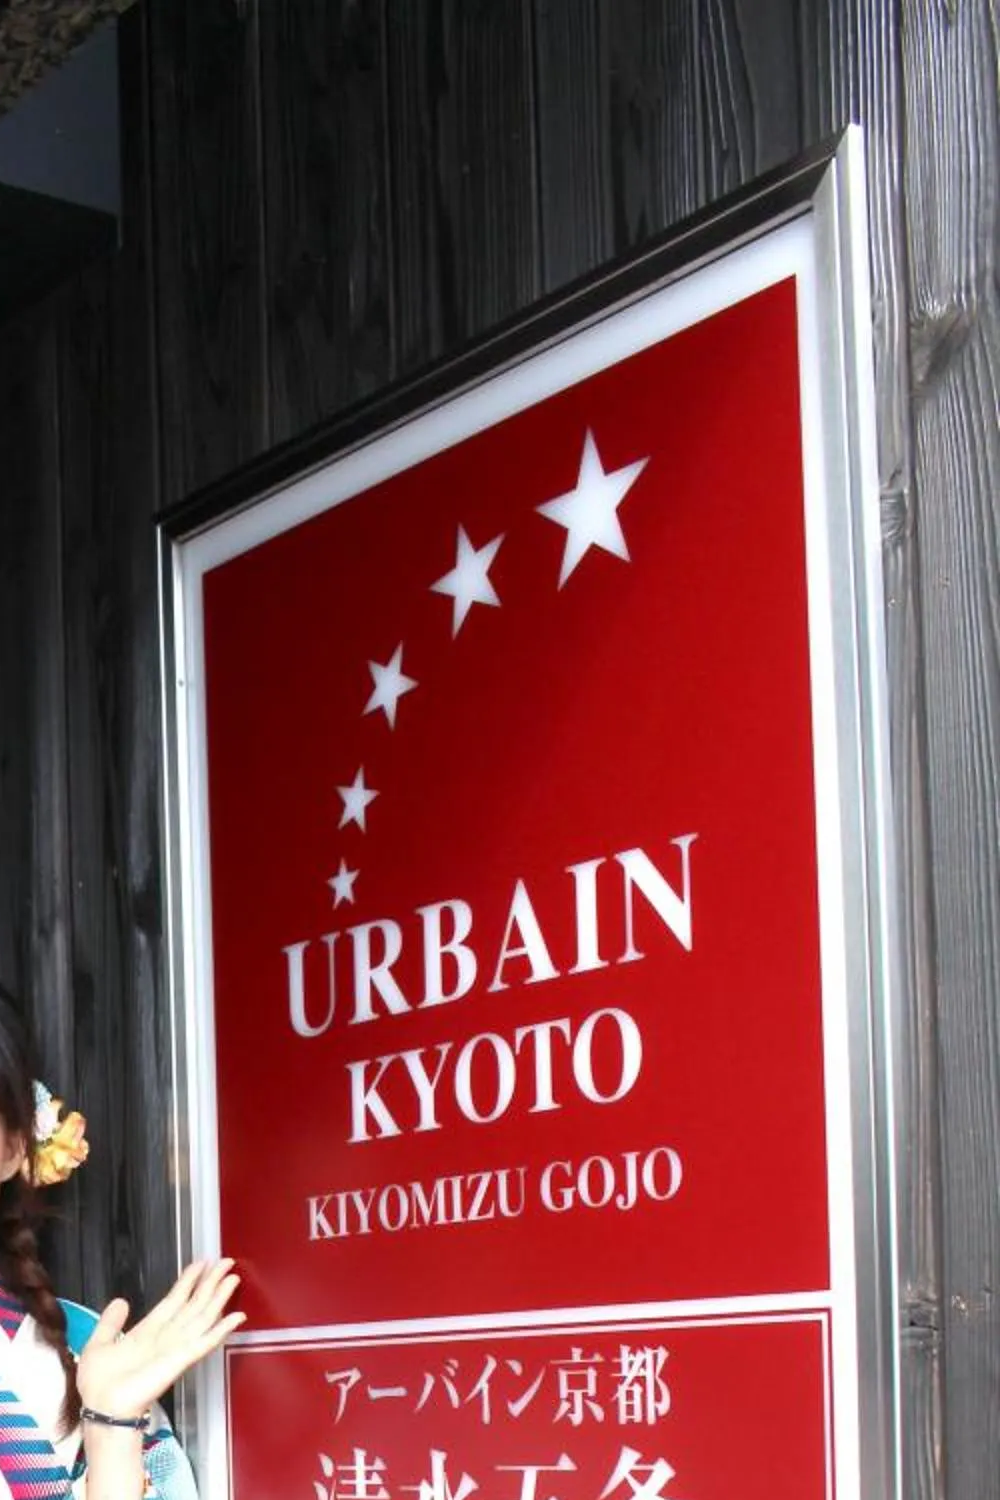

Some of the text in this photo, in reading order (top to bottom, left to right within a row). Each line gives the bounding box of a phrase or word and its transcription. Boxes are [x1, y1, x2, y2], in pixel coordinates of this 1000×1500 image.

[282, 832, 698, 1038] URBAIN
[345, 1007, 643, 1143] KYOTO
[306, 1147, 683, 1241] KIYOMIZU GOJO
[324, 1344, 671, 1427] アーバイン京都
